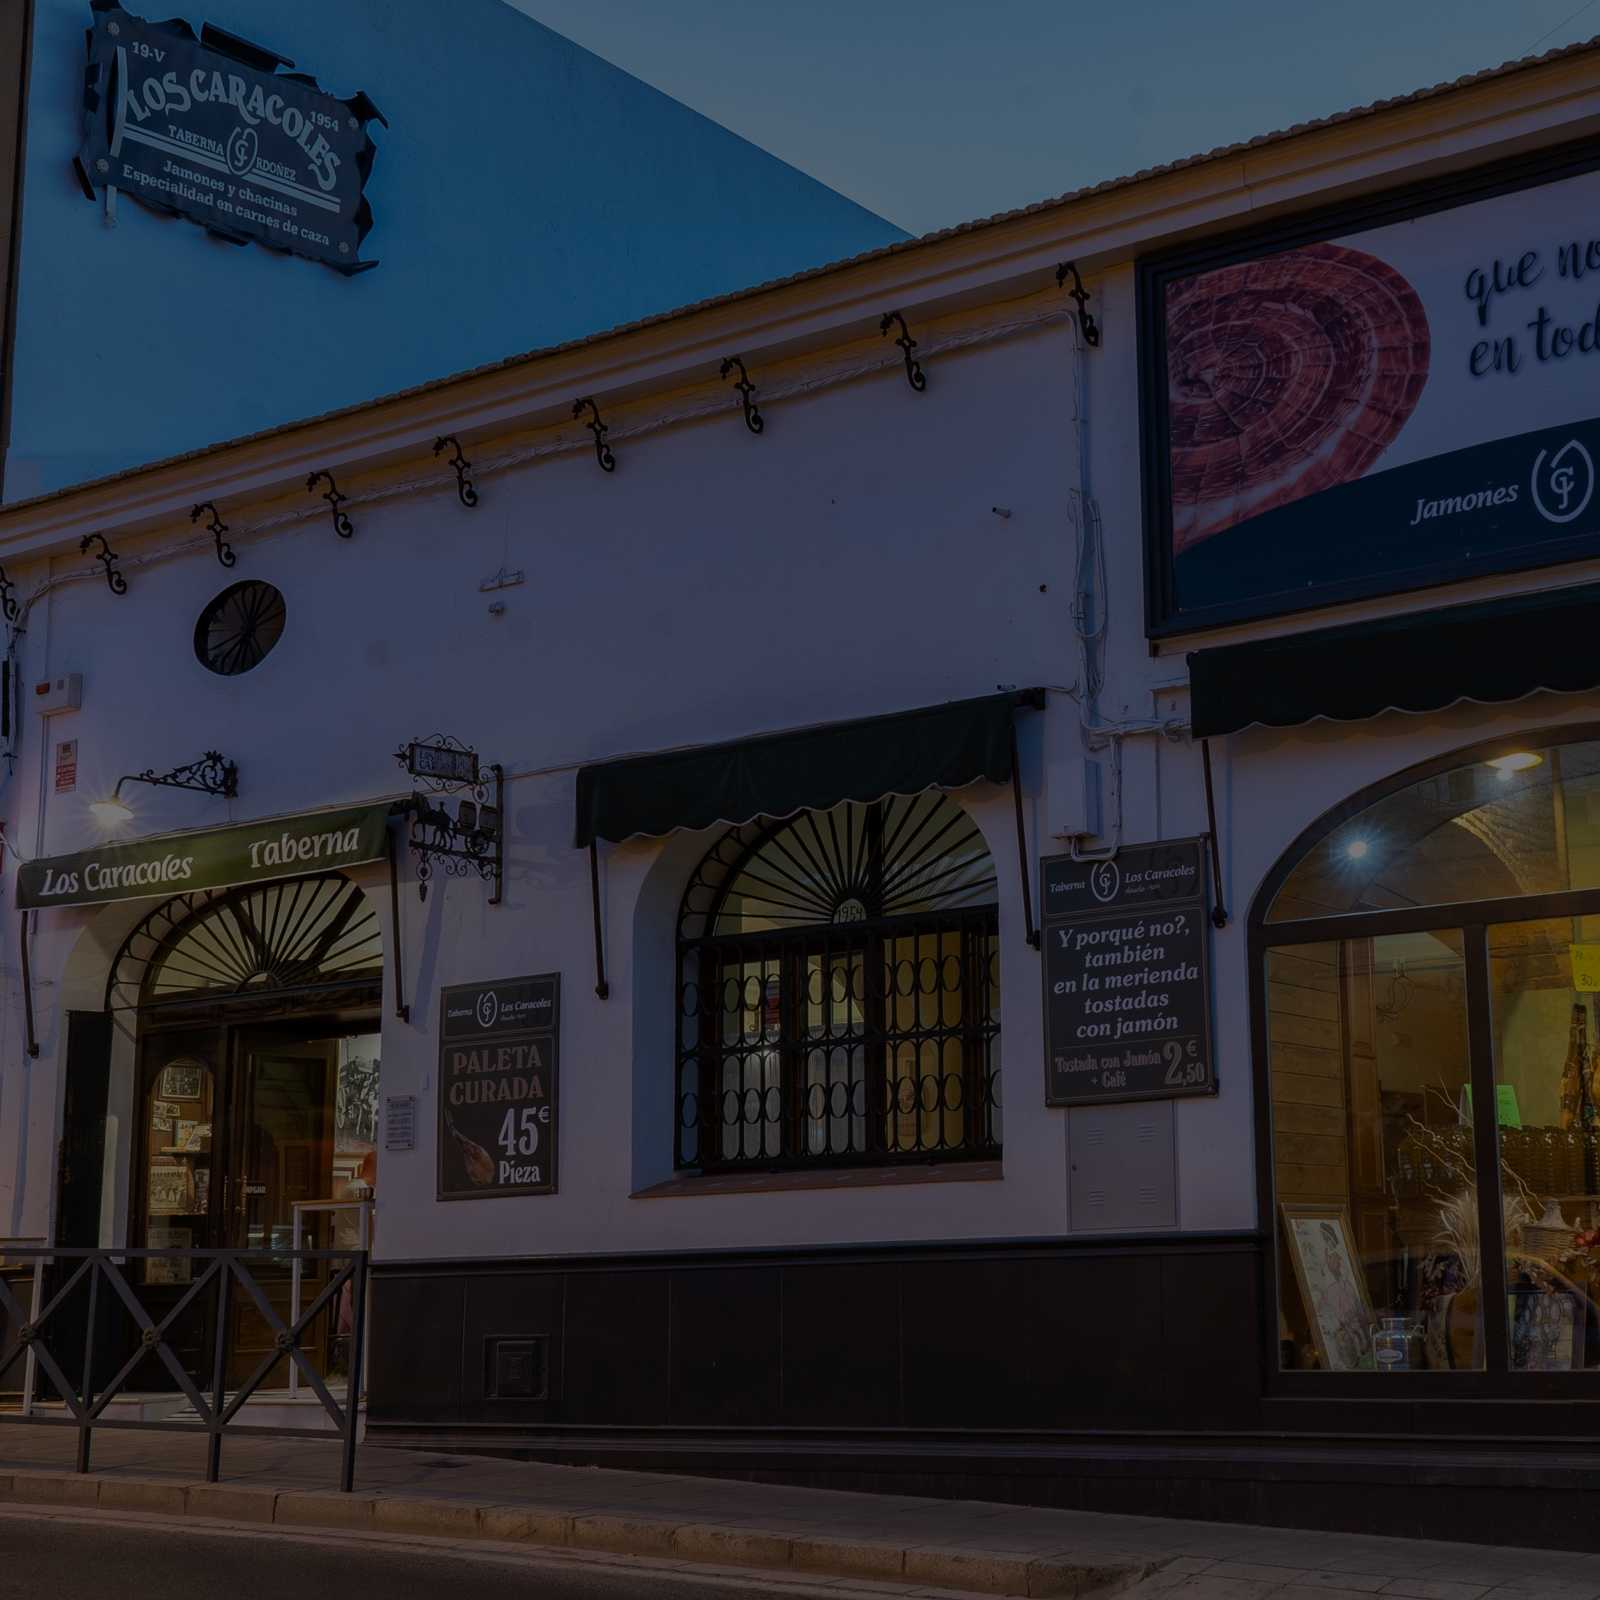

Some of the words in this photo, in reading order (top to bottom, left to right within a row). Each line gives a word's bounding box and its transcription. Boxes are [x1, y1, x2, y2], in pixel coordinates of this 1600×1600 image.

[127, 71, 192, 122] LOS
[190, 69, 342, 191] CARACOLES
[310, 111, 339, 132] 1954
[168, 124, 225, 156] TABERNA
[163, 160, 225, 192] Jamones
[228, 185, 236, 198] y
[239, 187, 298, 216] chacinas
[122, 165, 214, 207] Especialidad
[216, 199, 233, 214] en
[235, 206, 280, 231] carnes
[283, 219, 299, 236] de
[300, 228, 330, 246] caza
[1466, 252, 1544, 326] que
[1470, 337, 1522, 376] en
[1410, 483, 1520, 526] Jamones
[39, 869, 78, 896] Los
[84, 854, 193, 892] Caracoles
[248, 827, 361, 869] Taberna
[1125, 872, 1142, 883] Los
[1145, 864, 1196, 881] Caracoles
[1058, 928, 1074, 948] Y
[1075, 920, 1145, 951] porqué
[1084, 945, 1165, 968] también
[1054, 978, 1077, 994] en
[1082, 974, 1100, 992] la
[1105, 962, 1200, 989] merienda
[1084, 990, 1169, 1015] tostadas
[1076, 1024, 1111, 1039] con
[1114, 1012, 1179, 1040] jamón
[453, 1044, 543, 1076] PALETA
[449, 1073, 545, 1105] CURADA
[1102, 1070, 1127, 1089] Café
[498, 1159, 541, 1185] Pieza
